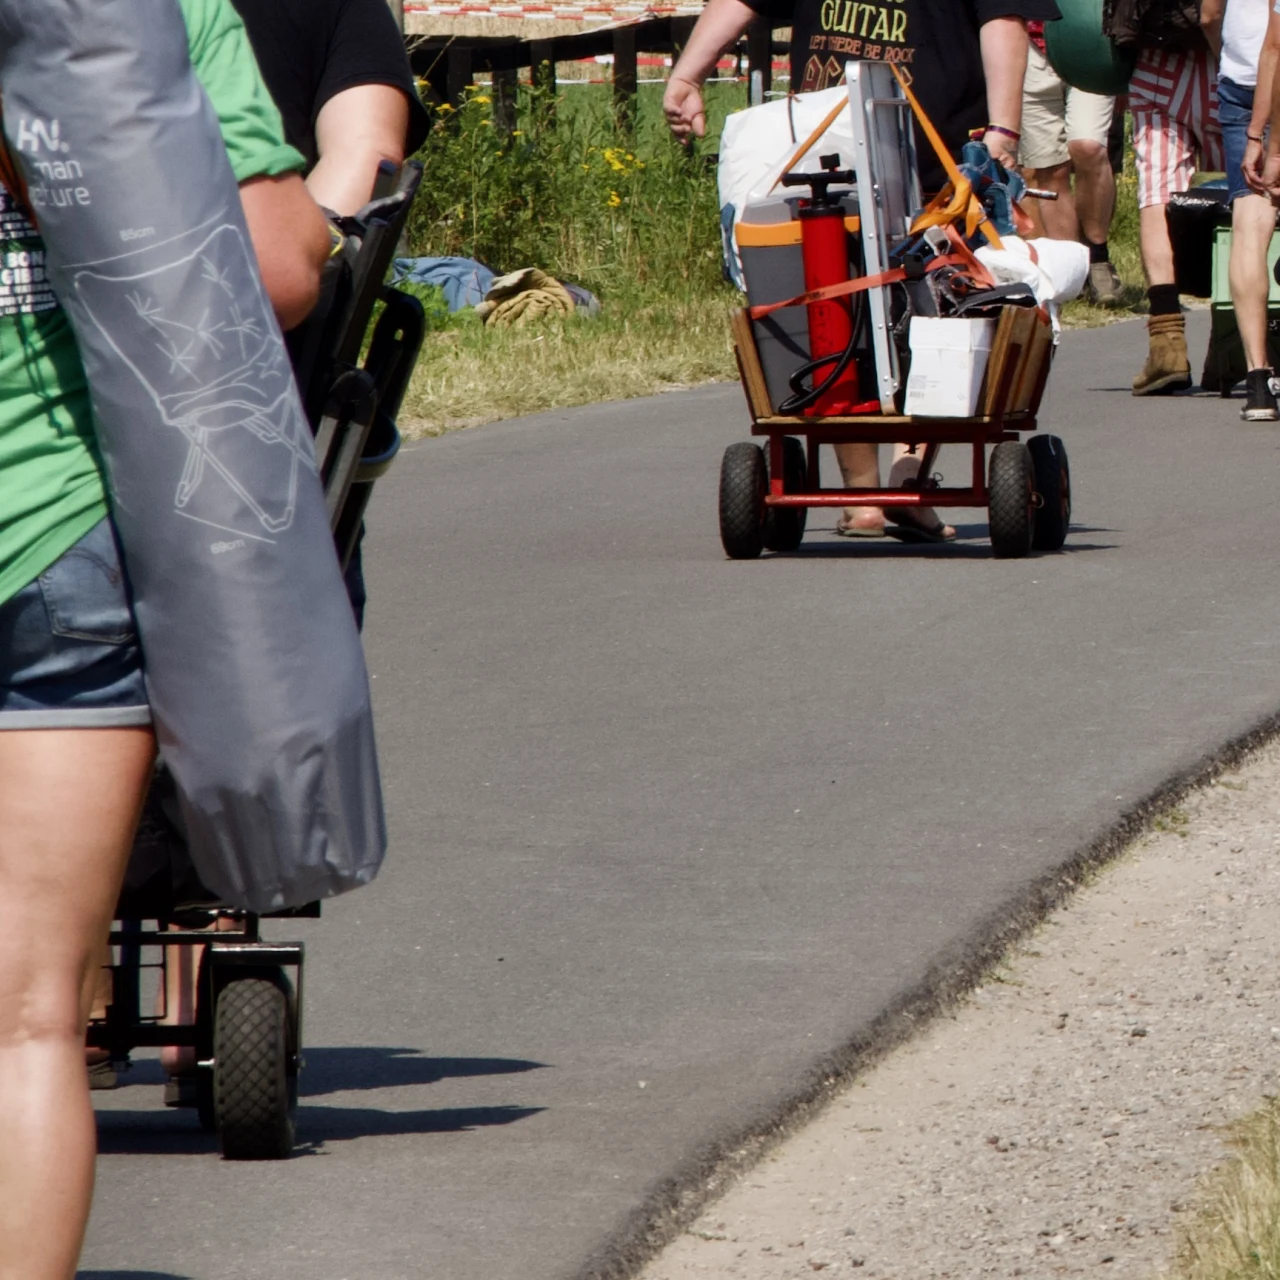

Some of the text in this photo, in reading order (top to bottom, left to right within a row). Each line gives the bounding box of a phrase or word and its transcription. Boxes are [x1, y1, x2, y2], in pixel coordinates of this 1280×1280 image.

[821, 0, 907, 43] GUITAR
[809, 36, 827, 51] LET
[863, 42, 881, 61] BE
[884, 47, 916, 64] ROCK
